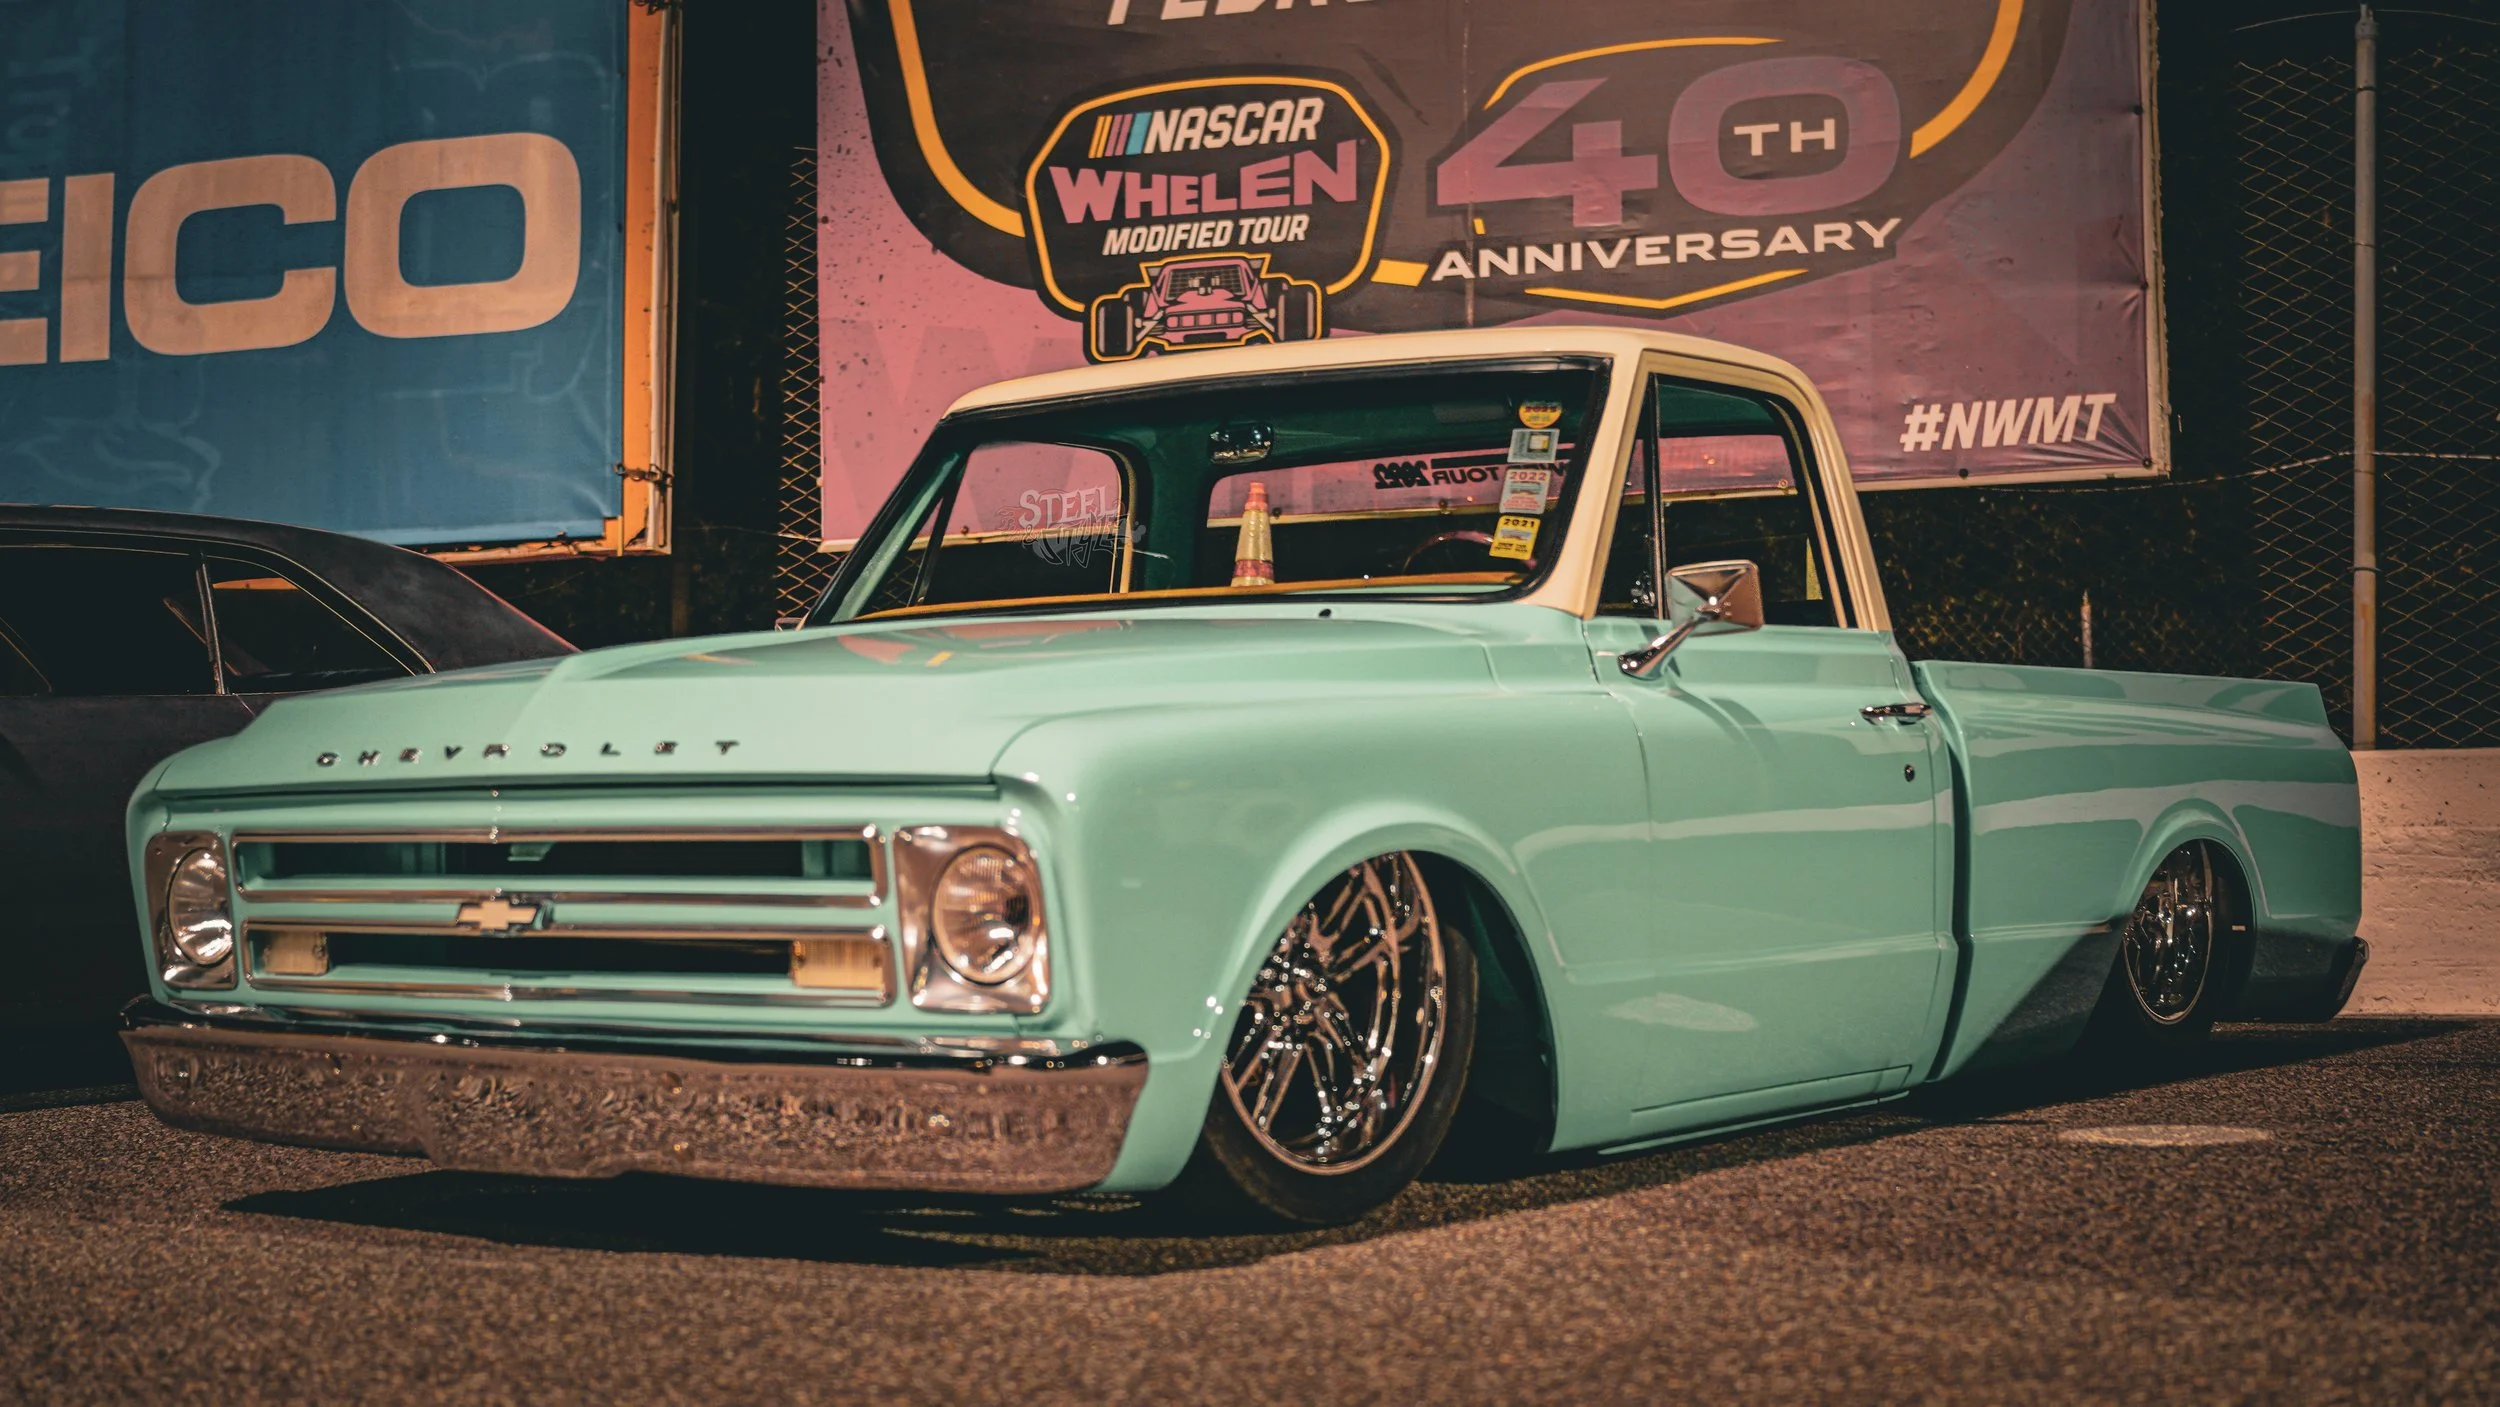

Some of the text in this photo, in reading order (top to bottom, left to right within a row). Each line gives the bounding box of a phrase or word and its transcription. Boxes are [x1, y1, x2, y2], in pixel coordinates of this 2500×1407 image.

[1144, 97, 1325, 154] NASCAR
[1437, 56, 1900, 227] 40
[1734, 119, 1836, 157] TH
[1048, 139, 1358, 224] WHELEN
[1102, 214, 1310, 256] MODIFIED TOUR
[1431, 218, 1902, 282] ANNIVERSARY
[1899, 393, 2117, 453] #NWMT
[1510, 471, 1547, 481] 2022
[1503, 518, 1535, 528] 2021
[316, 739, 741, 769] CHEVROLET
